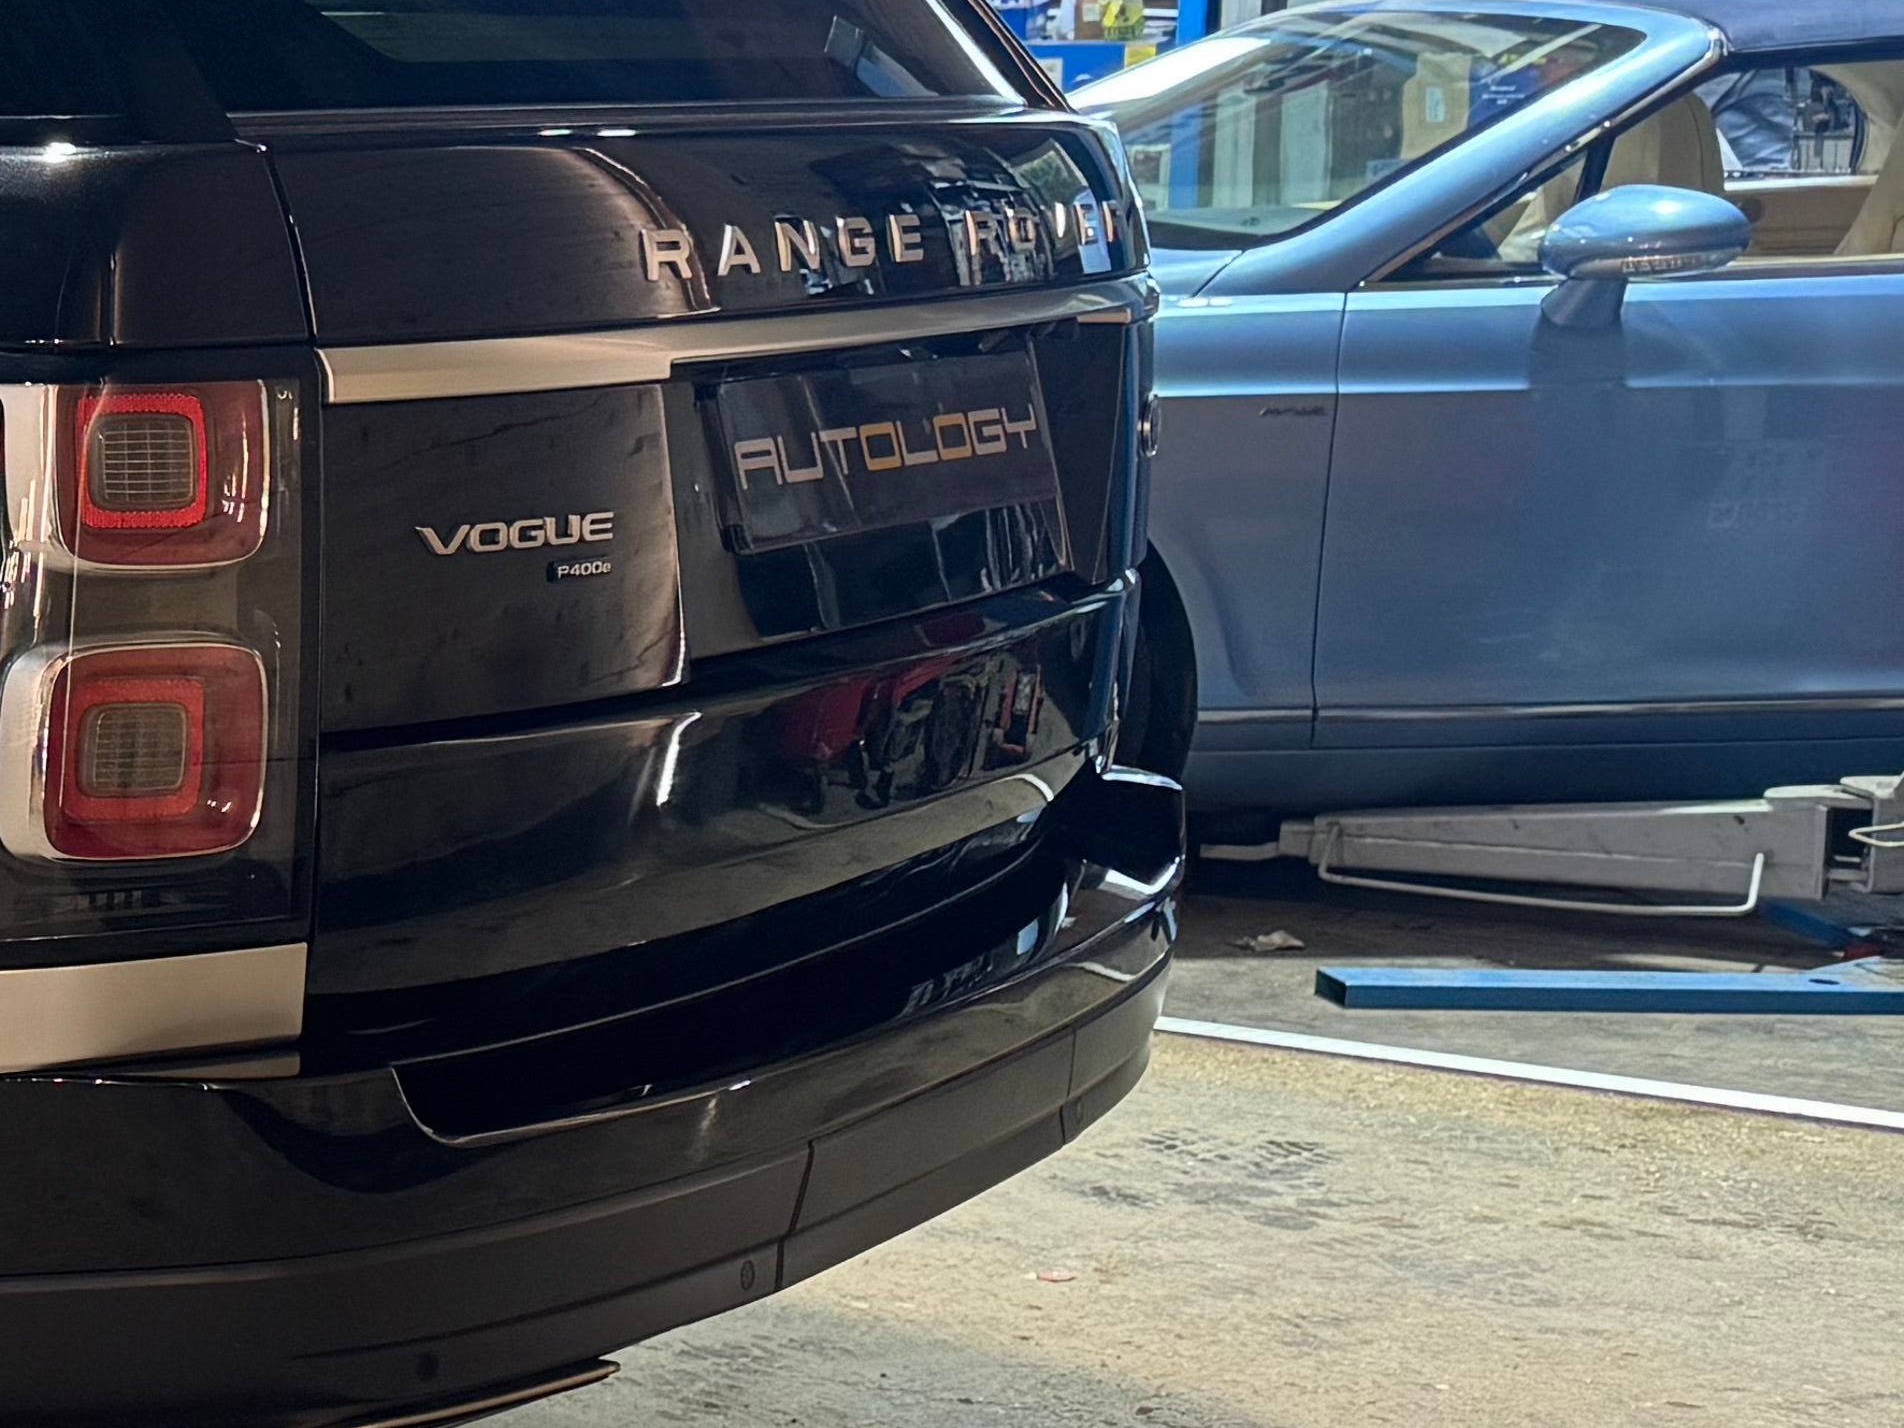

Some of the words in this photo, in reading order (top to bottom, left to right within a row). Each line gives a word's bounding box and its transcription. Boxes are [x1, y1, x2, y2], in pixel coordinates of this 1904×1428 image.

[640, 213, 927, 282] RANGE
[733, 403, 1038, 490] AUTOLOGY
[415, 510, 615, 556] VOGUE
[556, 560, 613, 580] P400e
